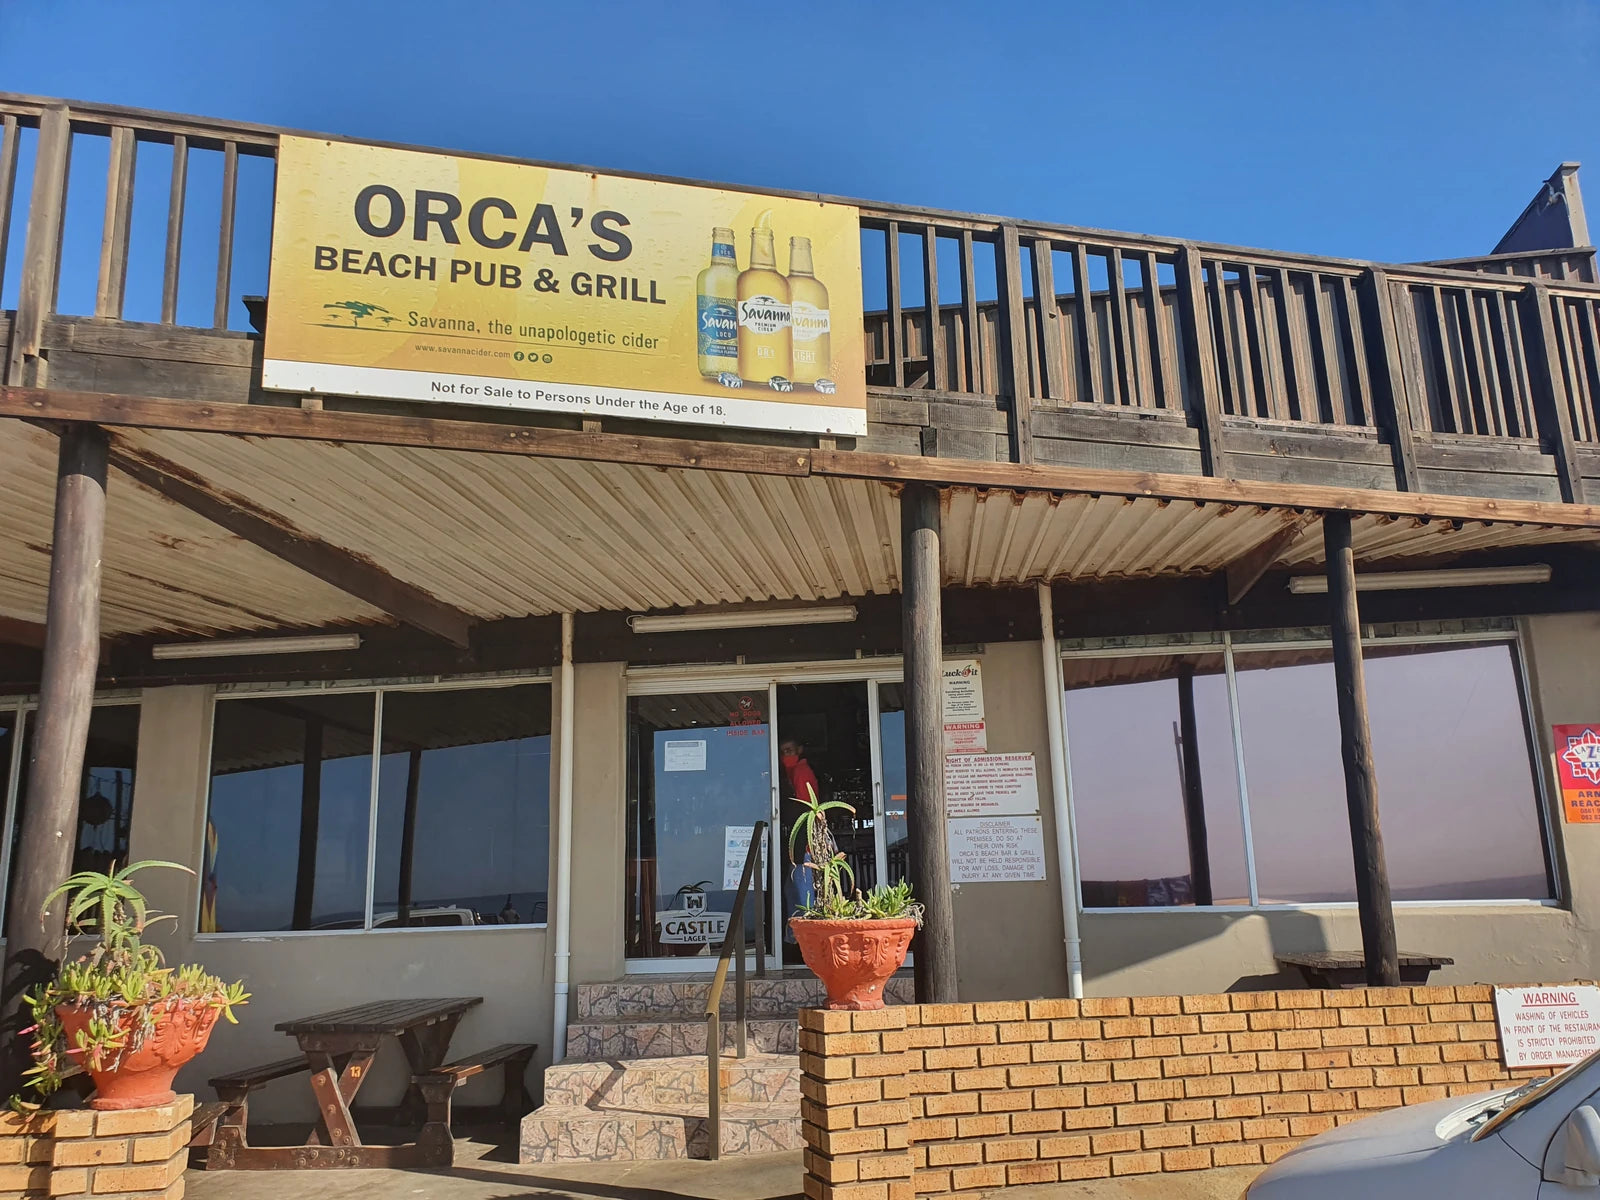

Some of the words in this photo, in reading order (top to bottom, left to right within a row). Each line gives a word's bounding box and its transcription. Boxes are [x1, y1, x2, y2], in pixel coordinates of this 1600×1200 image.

[354, 184, 633, 262] ORCA'S
[314, 245, 437, 281] BEACH
[450, 258, 522, 289] PUB
[533, 268, 560, 294] &
[570, 271, 666, 305] GRILL
[742, 302, 791, 322] Savanna
[702, 312, 738, 330] Savan
[792, 316, 828, 329] vanna
[408, 311, 480, 334] Savanna,
[488, 320, 512, 335] the
[520, 324, 616, 346] unapologetic
[622, 332, 658, 350] cider
[415, 344, 511, 358] www.savannacider.com
[431, 381, 456, 394] Not
[460, 384, 480, 395] for
[484, 386, 513, 398] Sale
[518, 389, 531, 400] to
[536, 390, 591, 404] Persons
[596, 395, 635, 409] Under
[639, 400, 659, 410] the
[663, 401, 688, 414] Age
[692, 404, 704, 414] of
[708, 405, 726, 416] 18.
[1574, 746, 1600, 758] LAZE
[665, 920, 725, 935] CASTLE
[1523, 992, 1576, 1004] WARNING
[1515, 1012, 1545, 1021] WASHING
[1548, 1012, 1556, 1020] OF
[1560, 1010, 1589, 1019] VEHICLES
[1514, 1025, 1534, 1034] FRONT
[1538, 1025, 1546, 1033] OF
[1549, 1024, 1561, 1032] THE
[1565, 1023, 1600, 1032] RESTAURAN
[1518, 1039, 1524, 1048] IS
[1528, 1038, 1555, 1047] STRICTLY
[1559, 1036, 1596, 1046] PROHIBITED
[1519, 1052, 1526, 1060] BY
[1531, 1051, 1552, 1060] ORDER
[1556, 1049, 1594, 1058] MANAGEME
[350, 1066, 361, 1078] 13
